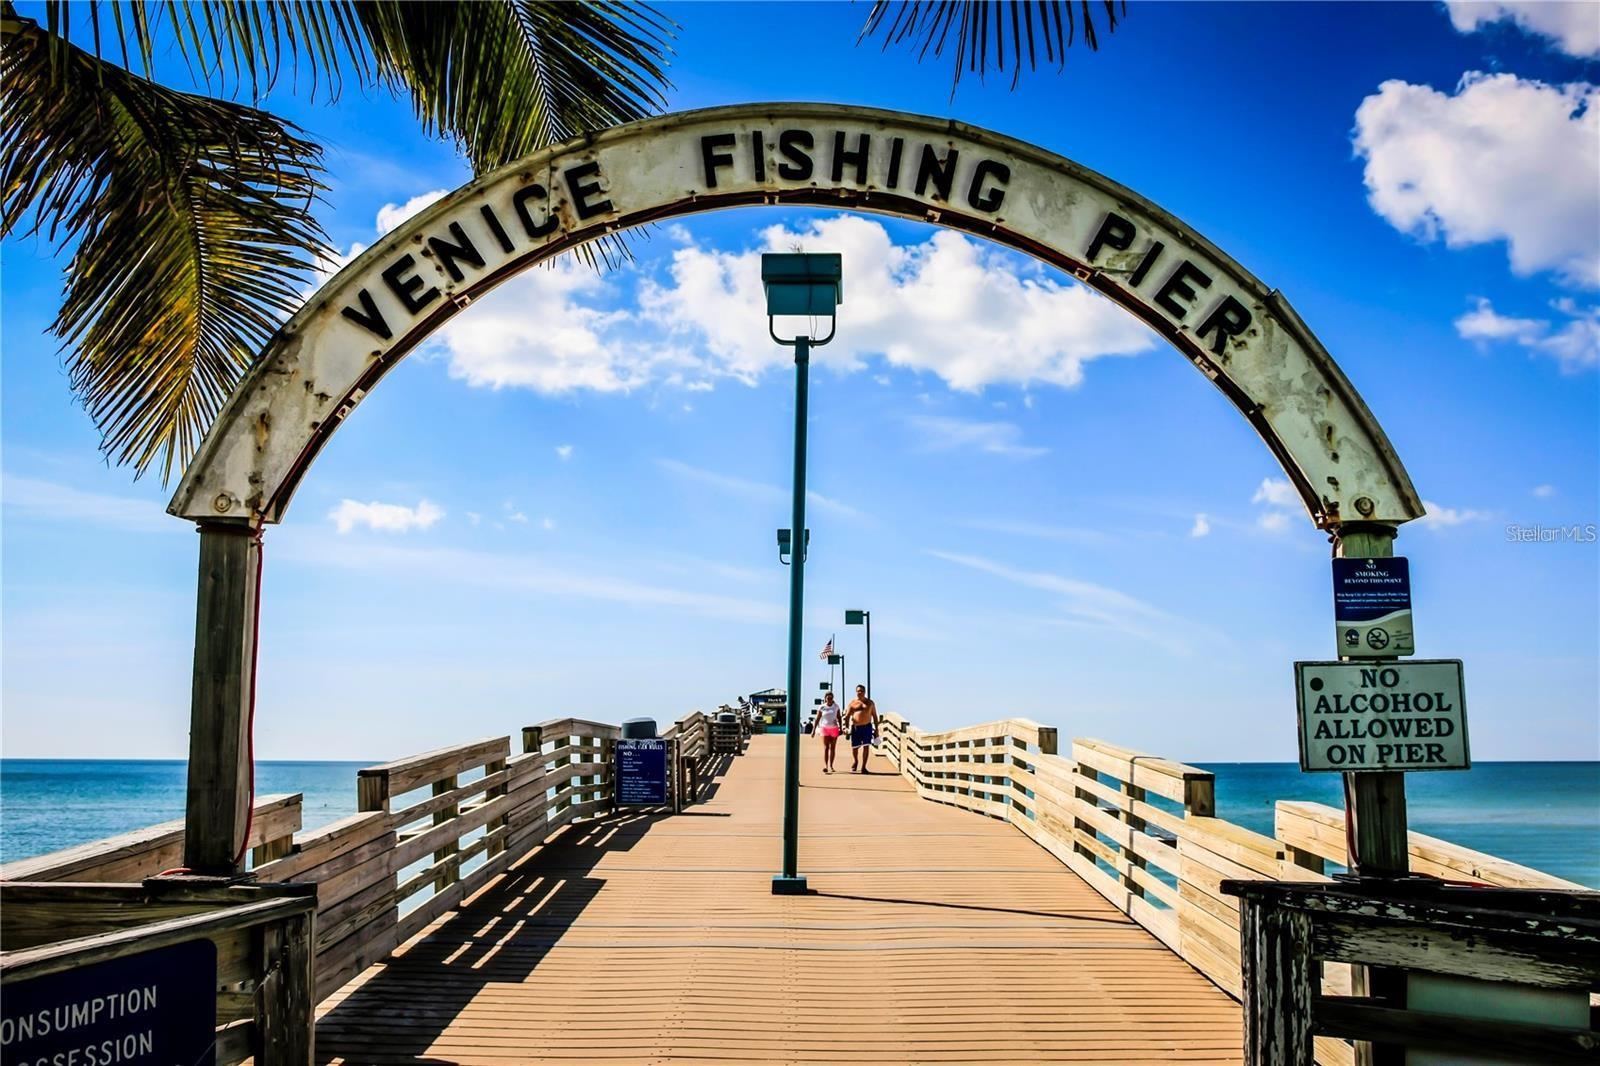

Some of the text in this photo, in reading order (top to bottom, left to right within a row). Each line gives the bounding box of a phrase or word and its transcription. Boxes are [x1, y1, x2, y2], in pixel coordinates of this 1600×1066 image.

[340, 129, 1253, 357] VENICE FISHING PIER
[1360, 668, 1400, 688] NO
[1313, 692, 1452, 714] ALCOHOL
[1314, 717, 1455, 740] ALLOWED
[1326, 743, 1448, 765] ON PIER
